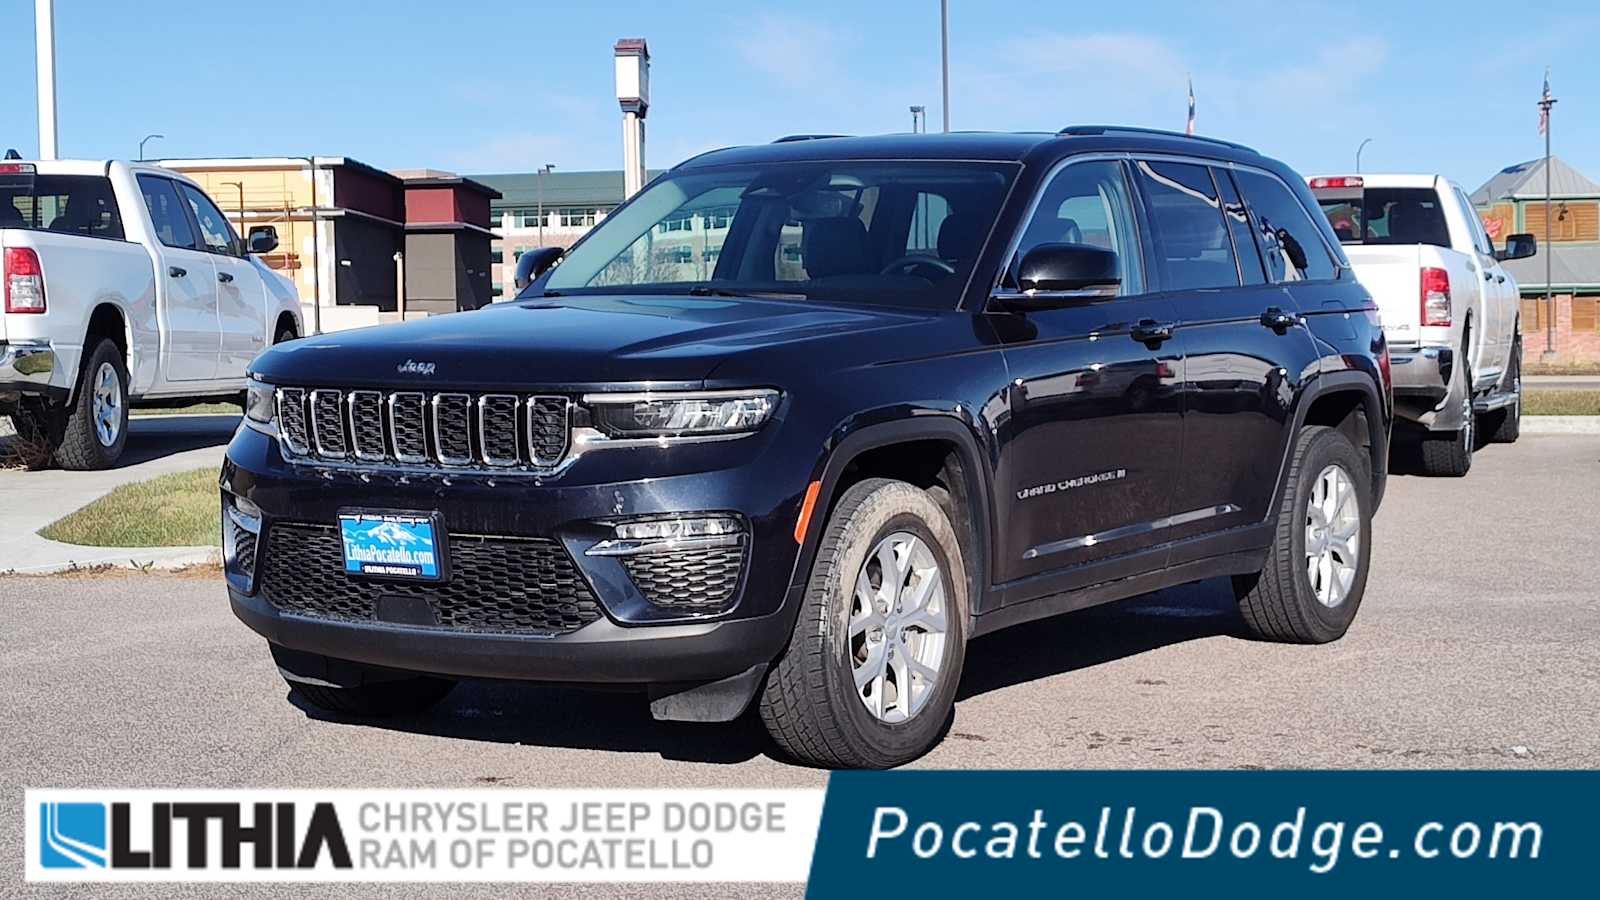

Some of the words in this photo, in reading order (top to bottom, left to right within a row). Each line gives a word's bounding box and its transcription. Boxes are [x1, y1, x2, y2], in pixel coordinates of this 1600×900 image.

[397, 359, 436, 374] Jeep
[1016, 483, 1057, 499] GRAND
[1057, 470, 1116, 490] CHEROKEE
[346, 543, 433, 564] LithiaPocatello.com
